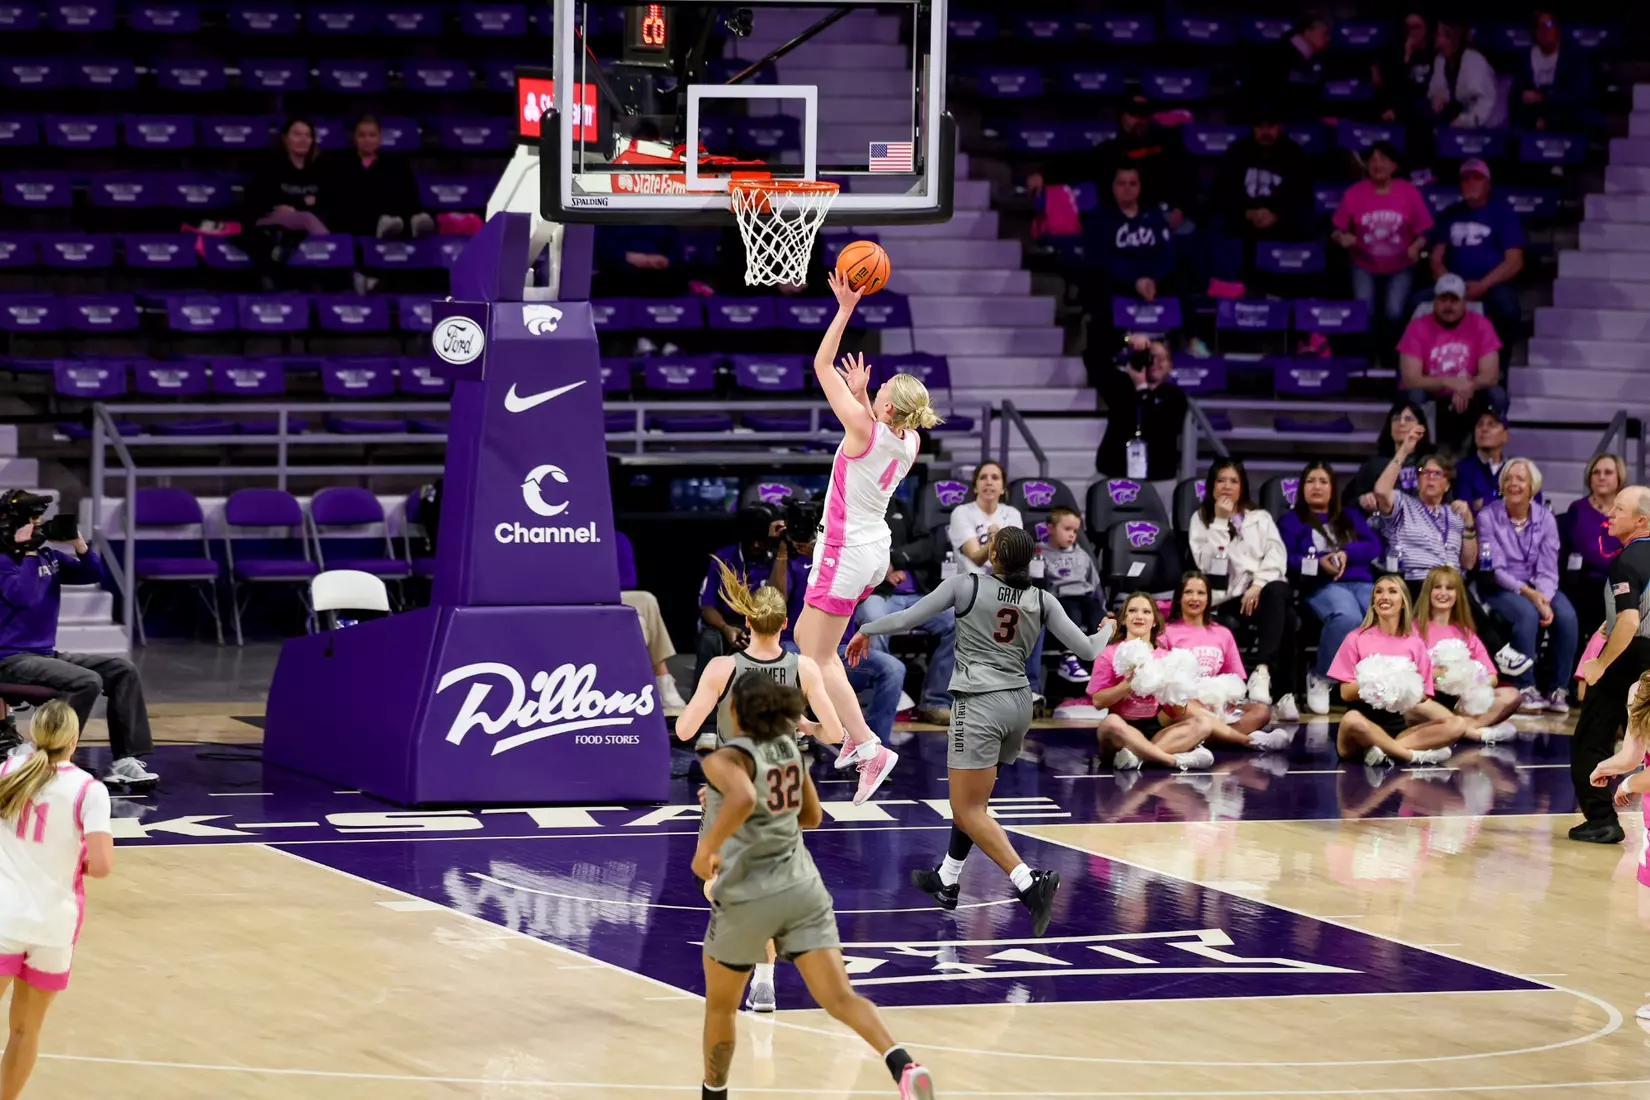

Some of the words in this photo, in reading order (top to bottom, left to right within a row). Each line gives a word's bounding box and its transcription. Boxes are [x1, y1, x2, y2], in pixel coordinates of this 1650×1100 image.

[660, 174, 687, 194] Farm
[571, 197, 608, 206] SPALDING
[443, 323, 475, 354] Ford
[878, 457, 899, 492] 4
[494, 521, 601, 543] Channel.
[997, 586, 1023, 605] GRAY
[993, 607, 1020, 644] 3
[436, 662, 654, 746] Dillons
[575, 735, 603, 744] FOOD
[605, 735, 640, 744] STORES
[955, 728, 964, 752] LOYAL
[766, 760, 800, 814] 32
[16, 799, 50, 844] 11
